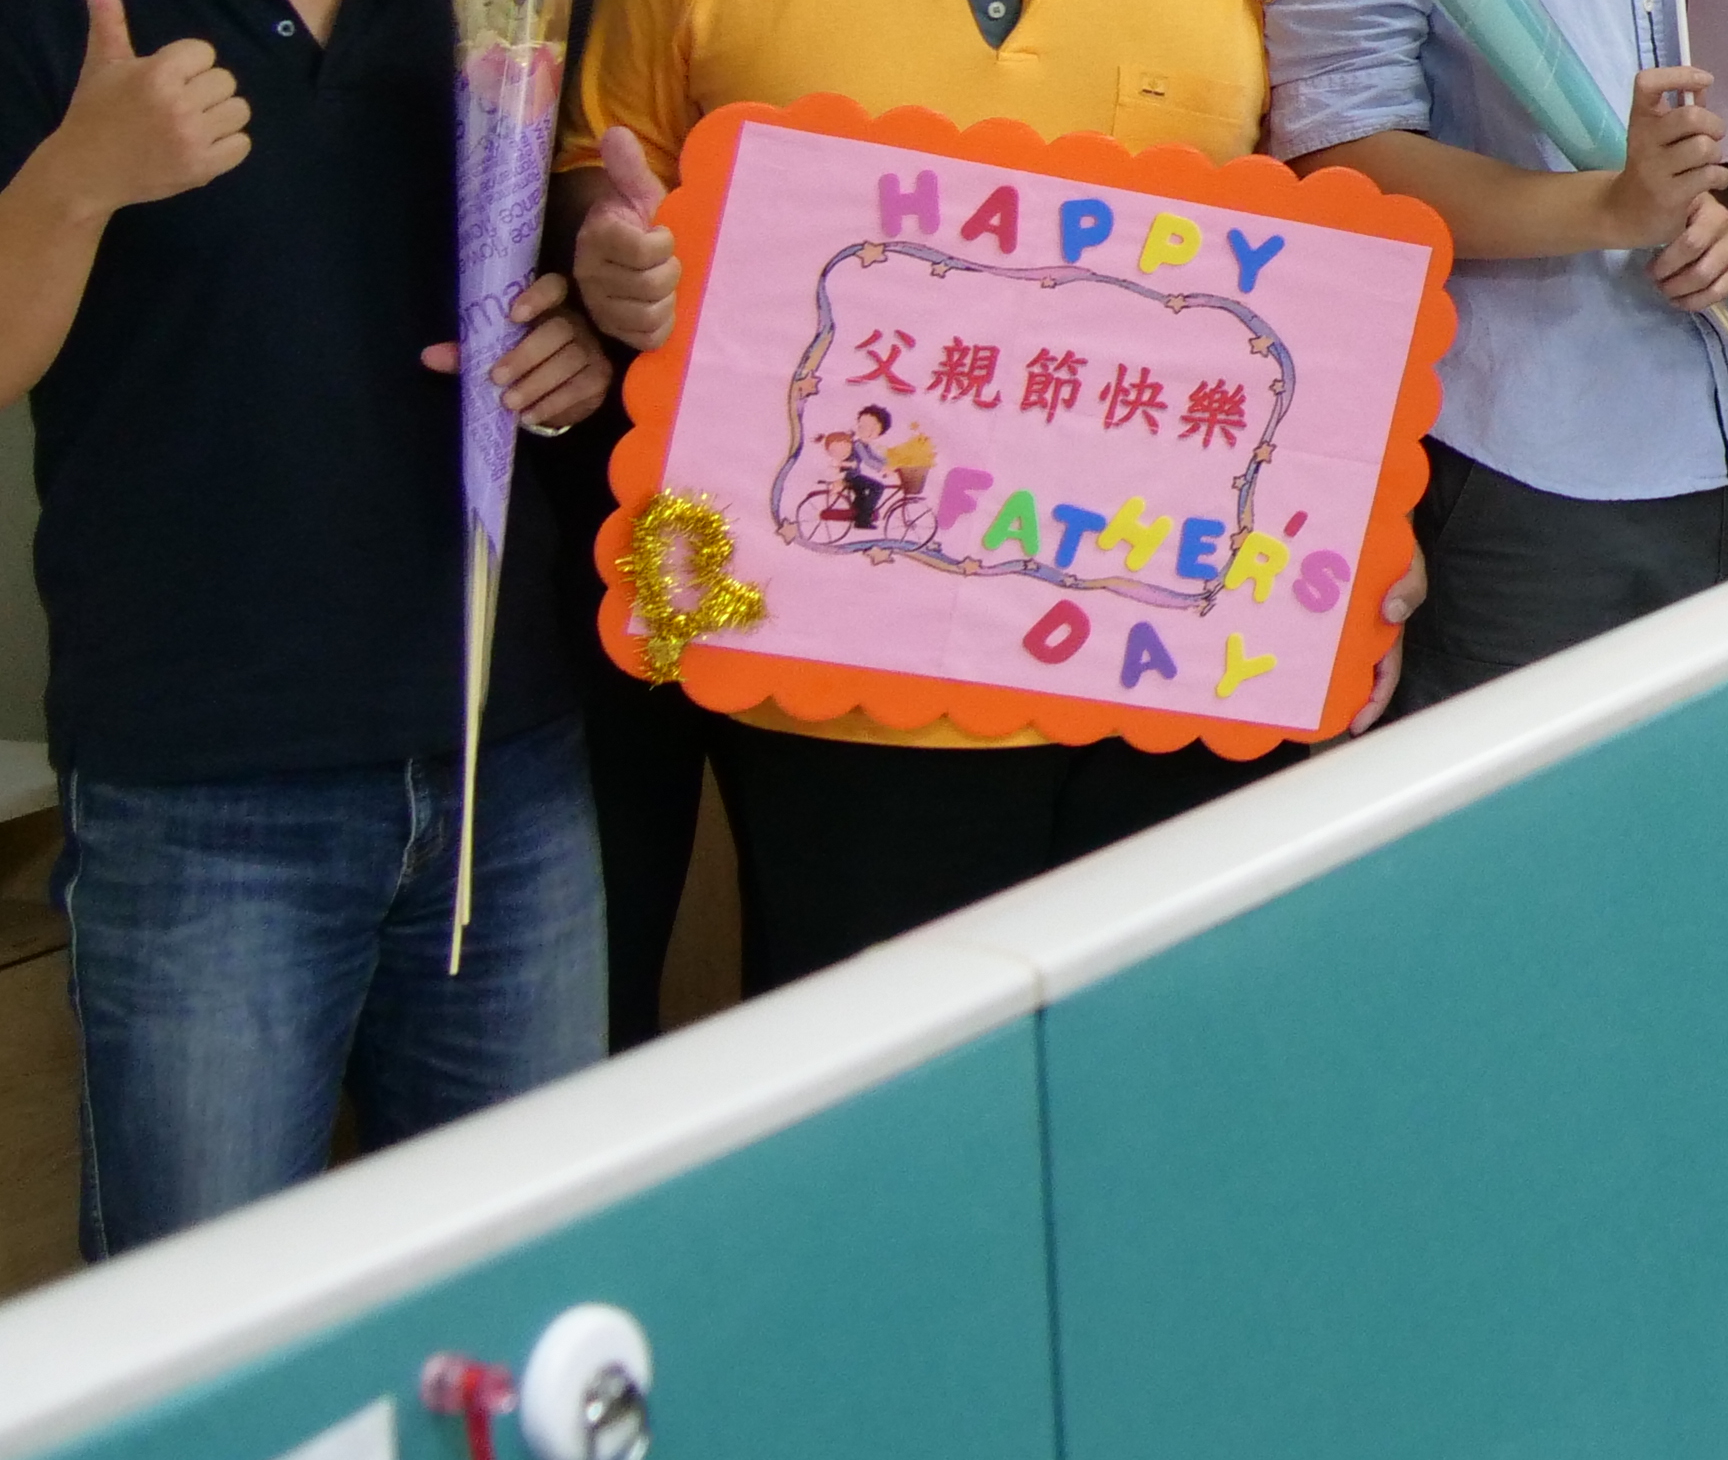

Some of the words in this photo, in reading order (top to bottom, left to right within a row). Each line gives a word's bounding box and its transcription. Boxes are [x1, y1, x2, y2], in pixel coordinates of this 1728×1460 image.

[877, 169, 1286, 294] HAPPY
[846, 327, 1250, 449] 父親節快樂
[937, 466, 1353, 614] FATHER'S
[1023, 599, 1278, 698] DAY
